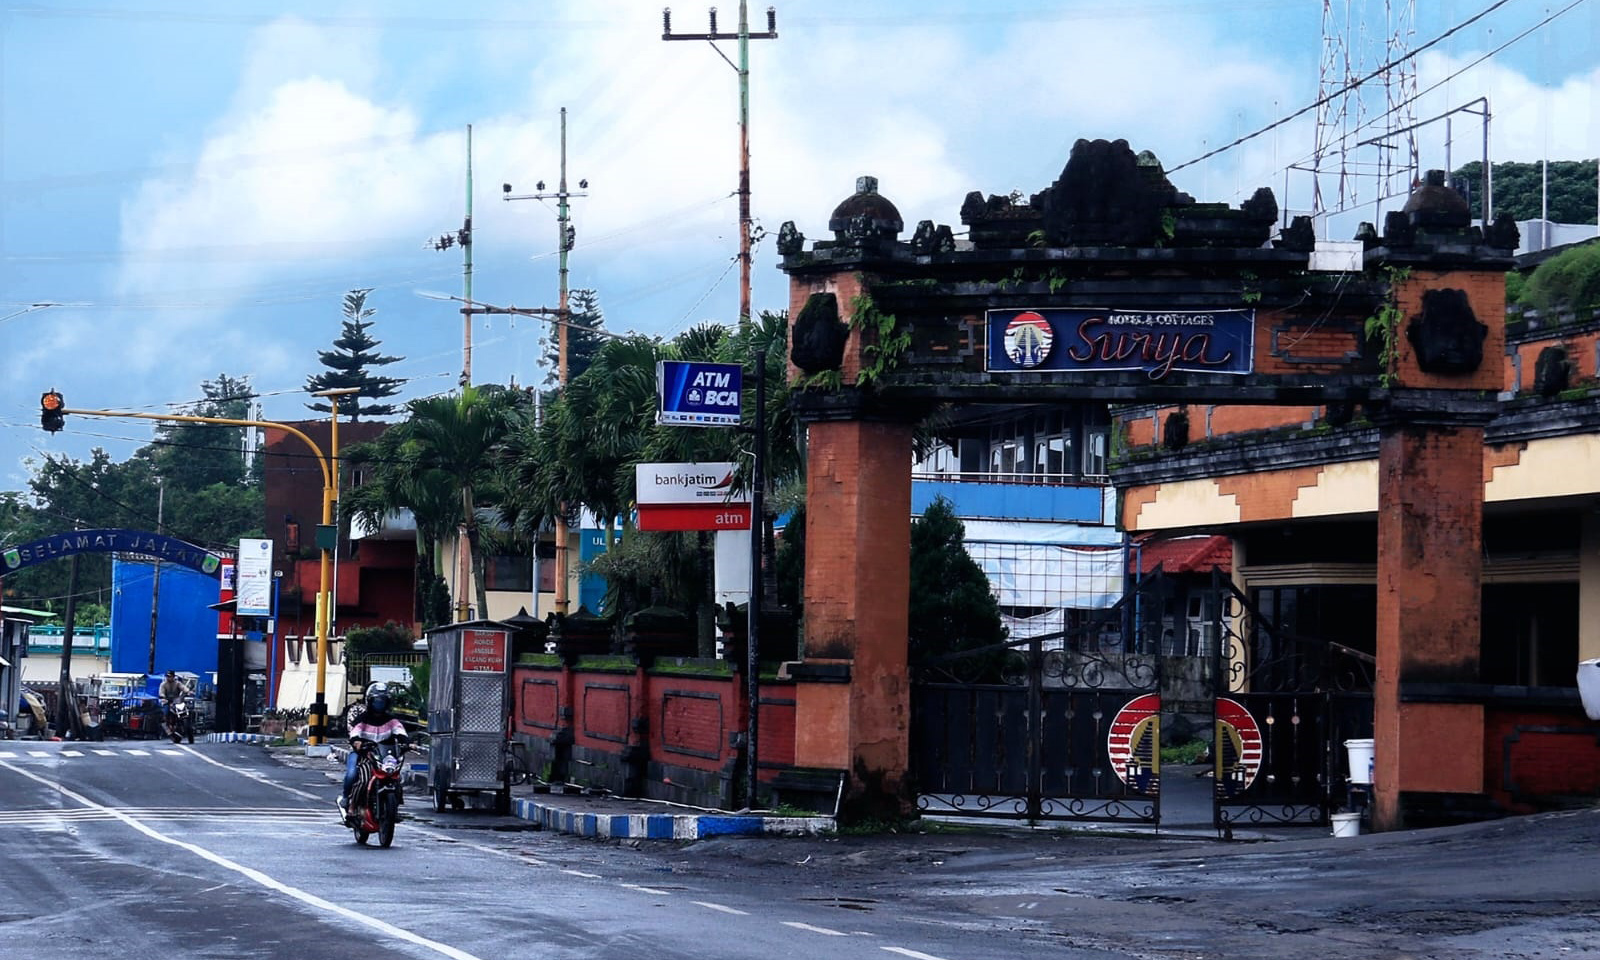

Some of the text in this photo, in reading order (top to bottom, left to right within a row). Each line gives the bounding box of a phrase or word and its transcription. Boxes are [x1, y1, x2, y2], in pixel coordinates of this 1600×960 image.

[1156, 314, 1214, 326] COTTAGES
[1069, 318, 1231, 380] Surya
[692, 371, 731, 388] ATM
[704, 390, 739, 406] BCA
[655, 473, 717, 487] bankjatim
[715, 513, 743, 525] atm
[21, 534, 201, 566] SELAMAT JALAN
